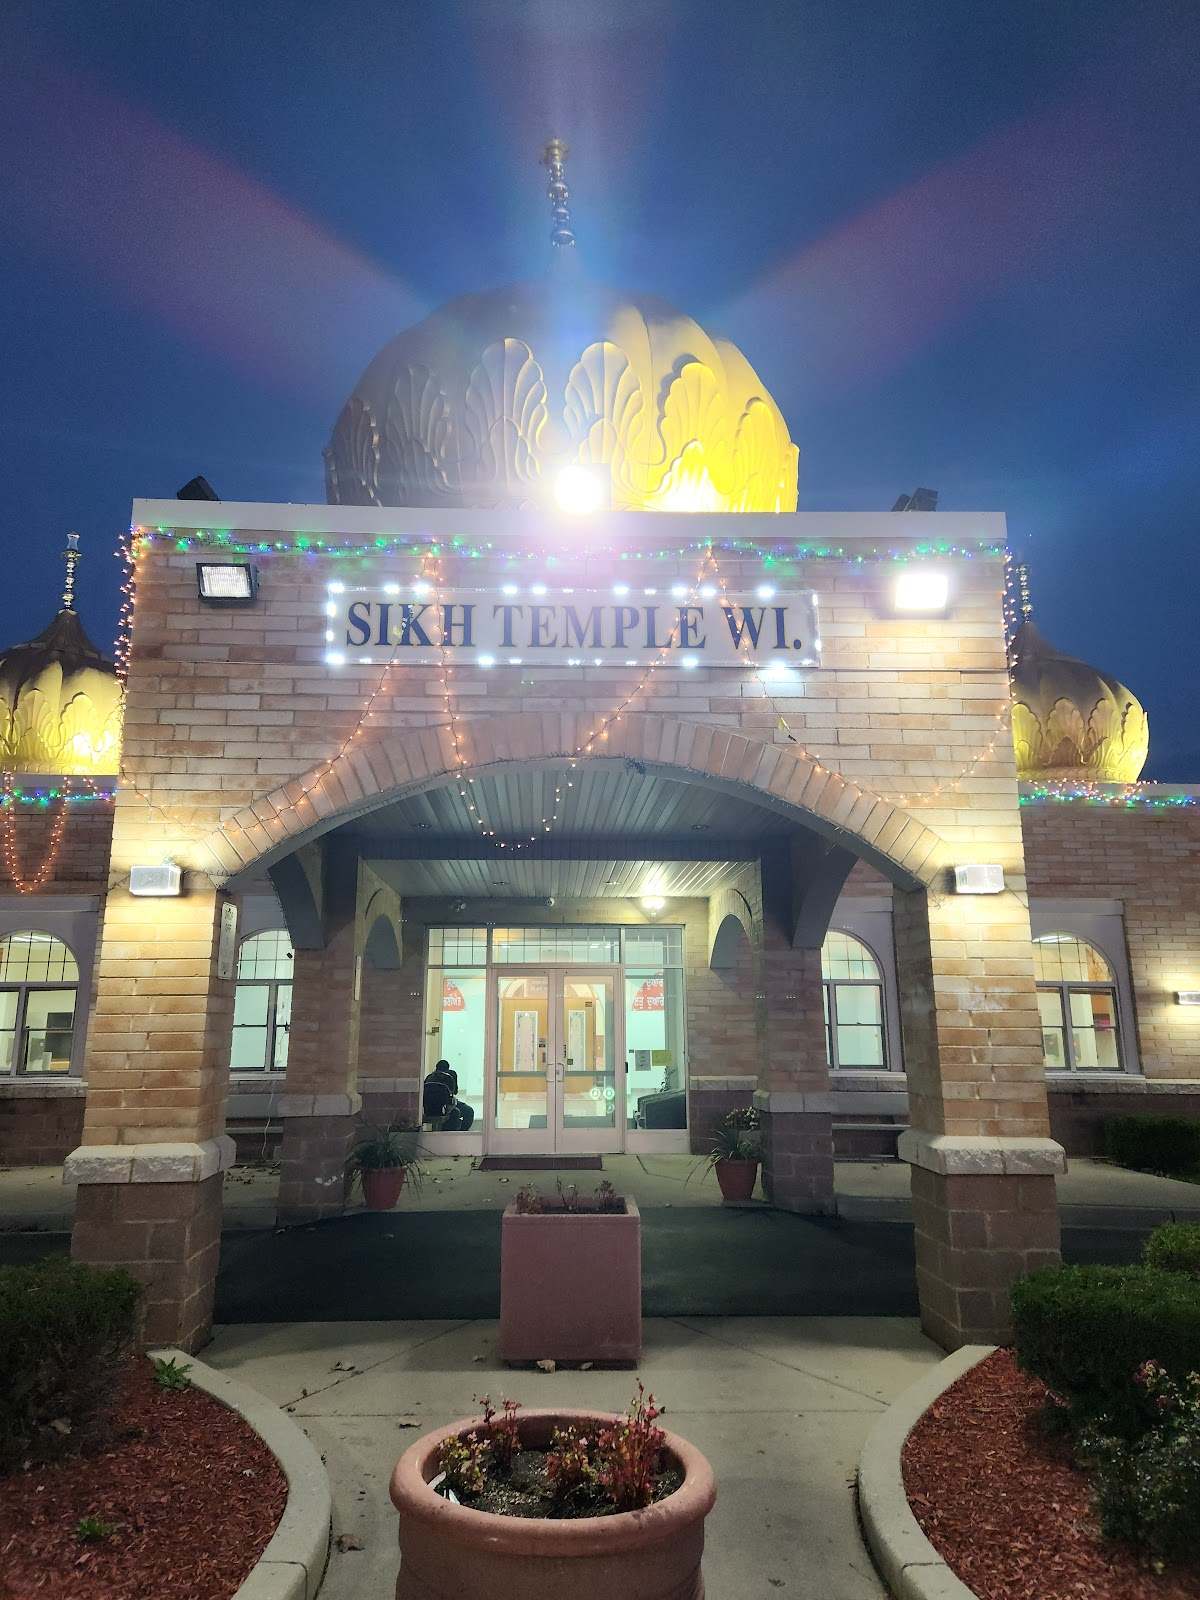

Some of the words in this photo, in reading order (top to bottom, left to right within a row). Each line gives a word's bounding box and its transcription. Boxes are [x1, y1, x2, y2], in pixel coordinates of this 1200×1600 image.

[347, 602, 476, 646] SIKH
[493, 605, 706, 649] TEMPLE
[721, 607, 802, 650] WI.
